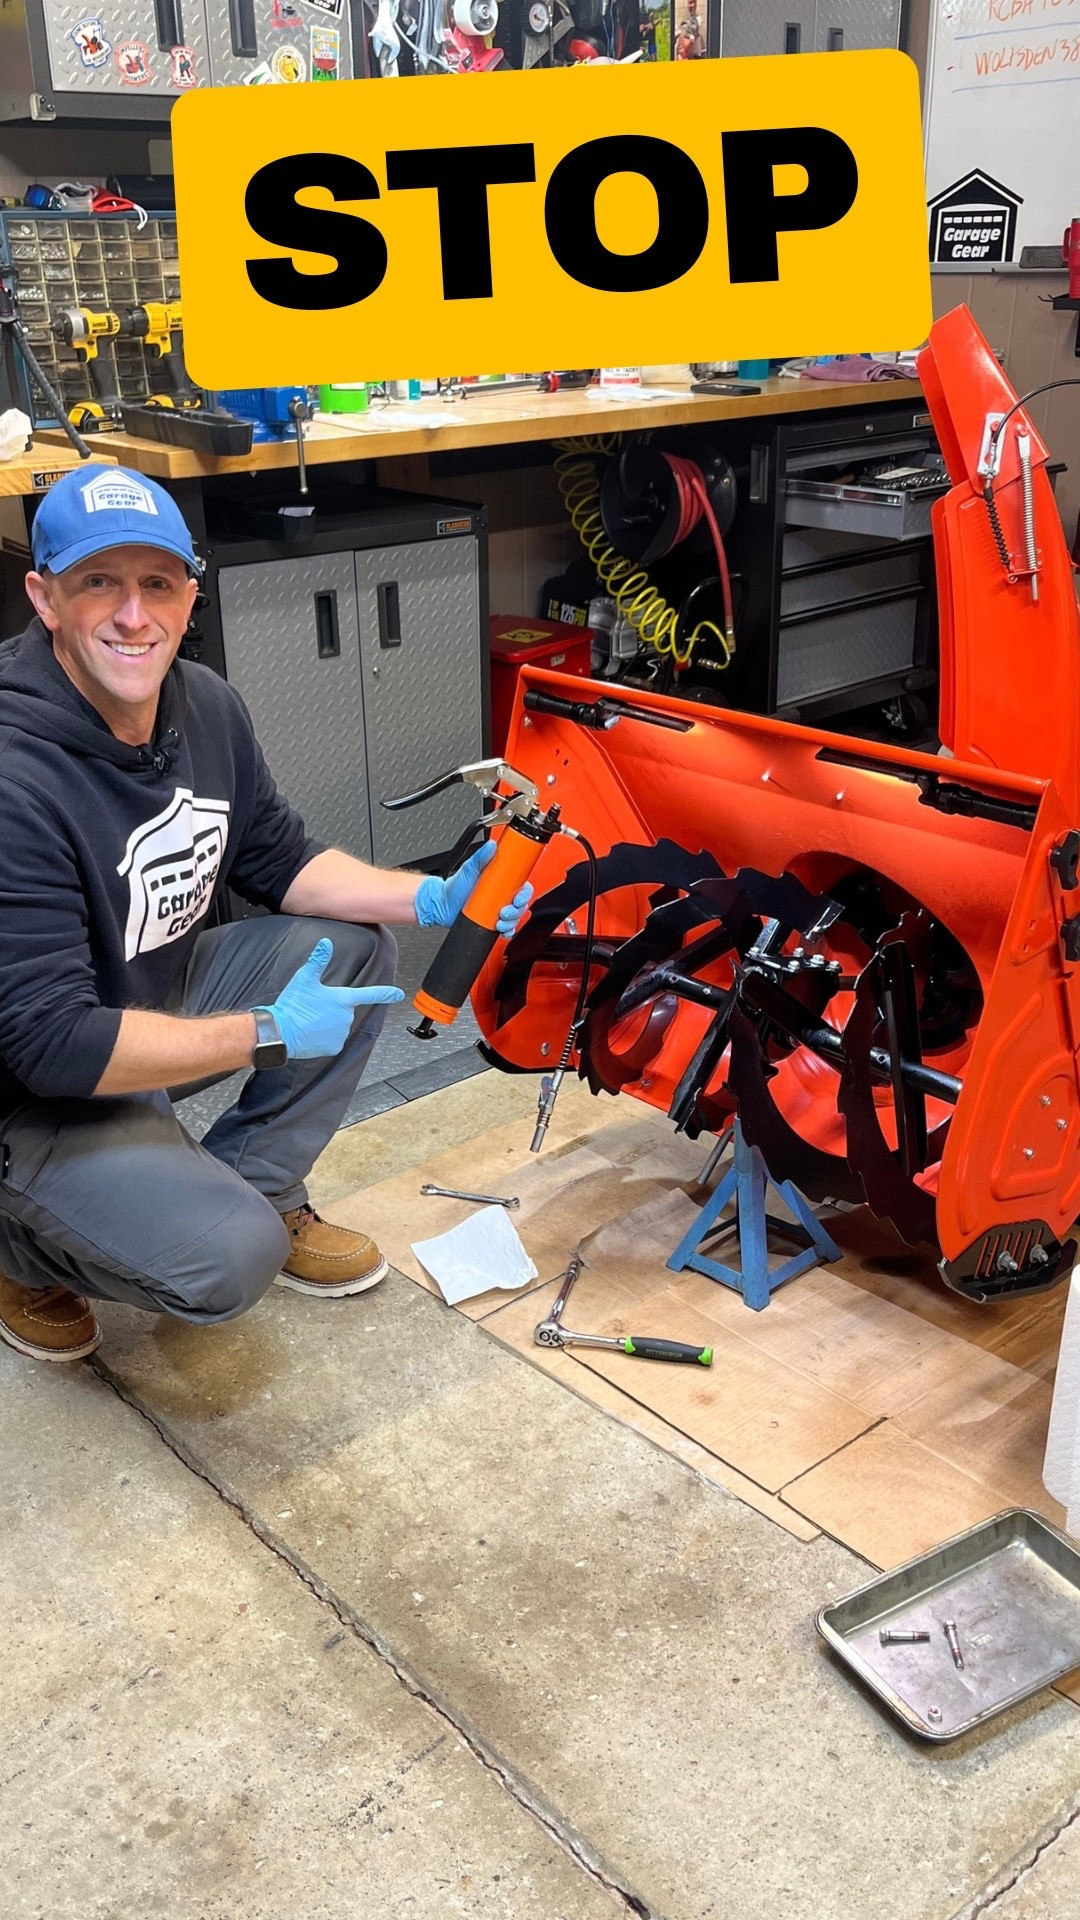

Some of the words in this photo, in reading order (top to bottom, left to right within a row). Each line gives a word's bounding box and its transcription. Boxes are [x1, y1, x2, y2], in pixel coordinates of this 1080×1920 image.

[944, 227, 1001, 243] Garage
[951, 244, 990, 258] Gear
[98, 493, 144, 502] Garage
[107, 499, 138, 507] Gear
[560, 603, 575, 624] 125
